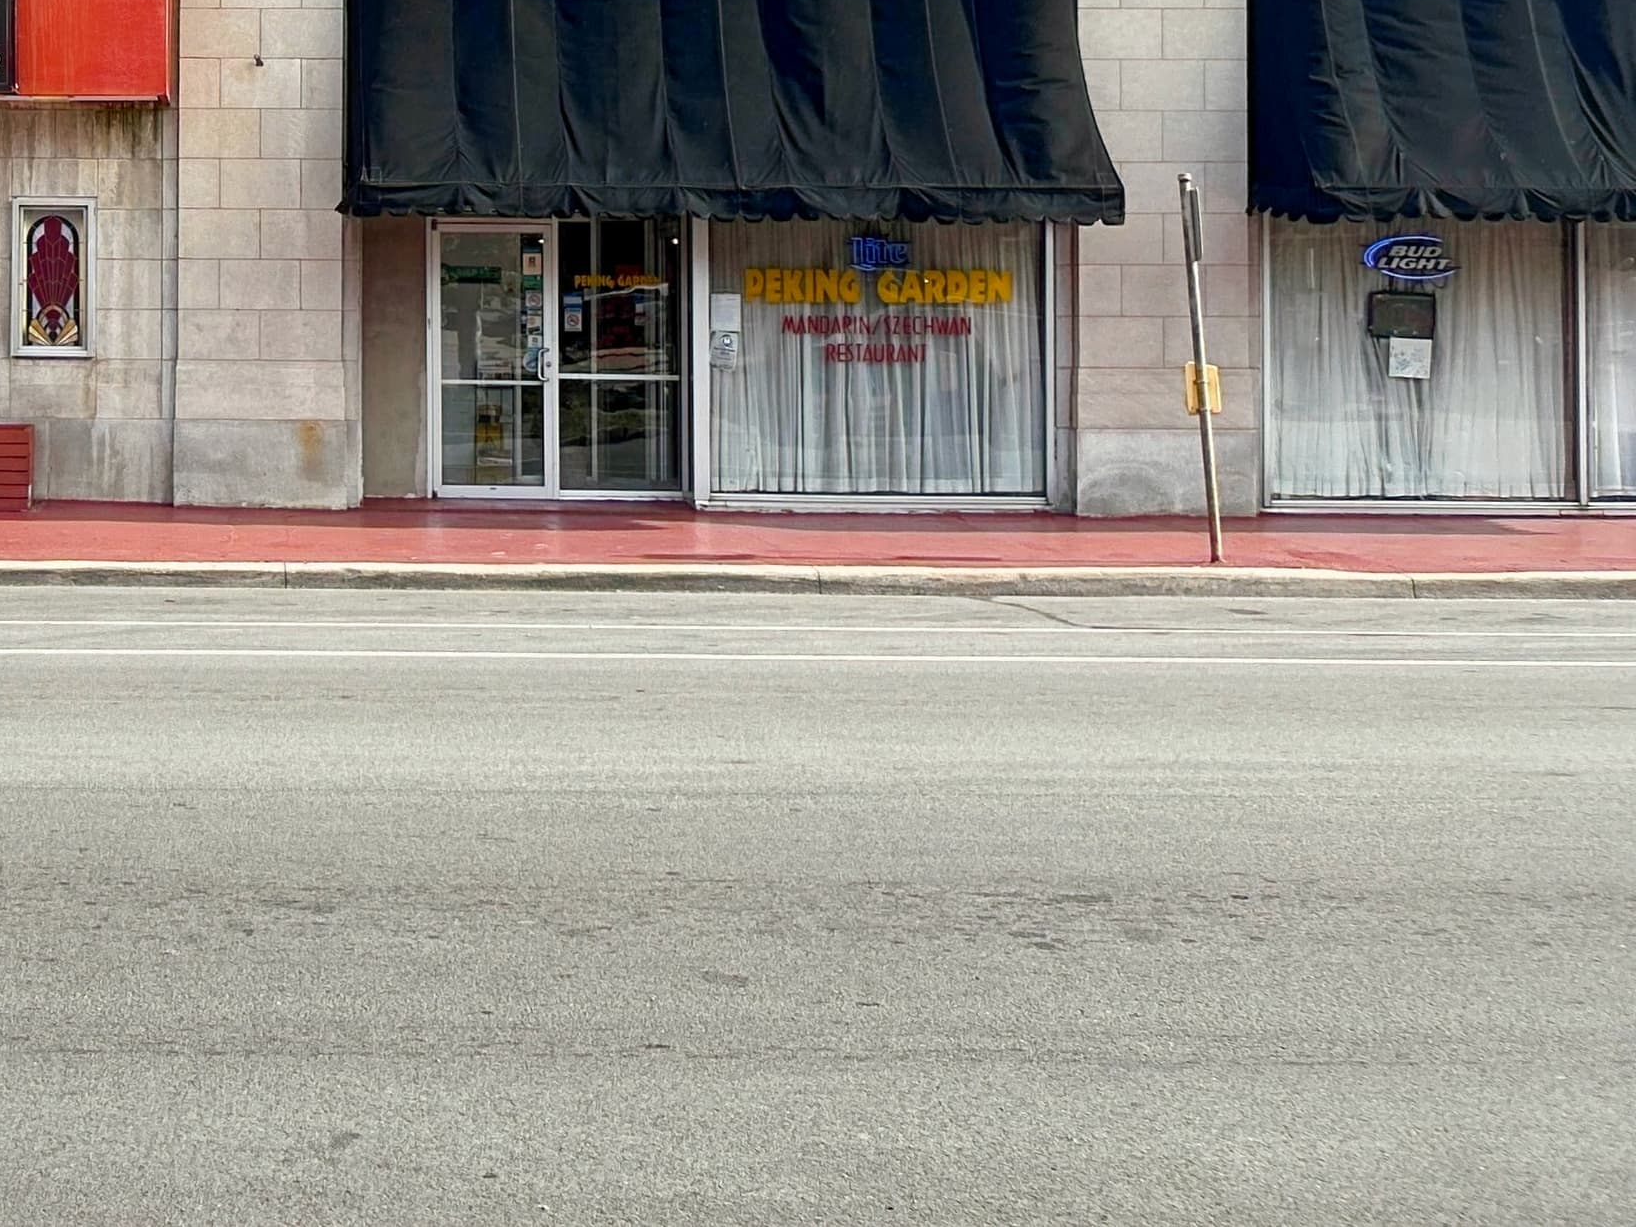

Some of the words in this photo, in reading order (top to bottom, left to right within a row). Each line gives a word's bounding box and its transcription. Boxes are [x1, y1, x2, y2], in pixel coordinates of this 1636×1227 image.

[850, 236, 909, 270] Lite
[1388, 245, 1443, 258] BUD
[1378, 259, 1450, 270] LIGHT
[744, 267, 861, 304] PEKING
[876, 267, 1014, 305] GARDEN
[824, 343, 927, 363] RESTAURANT
